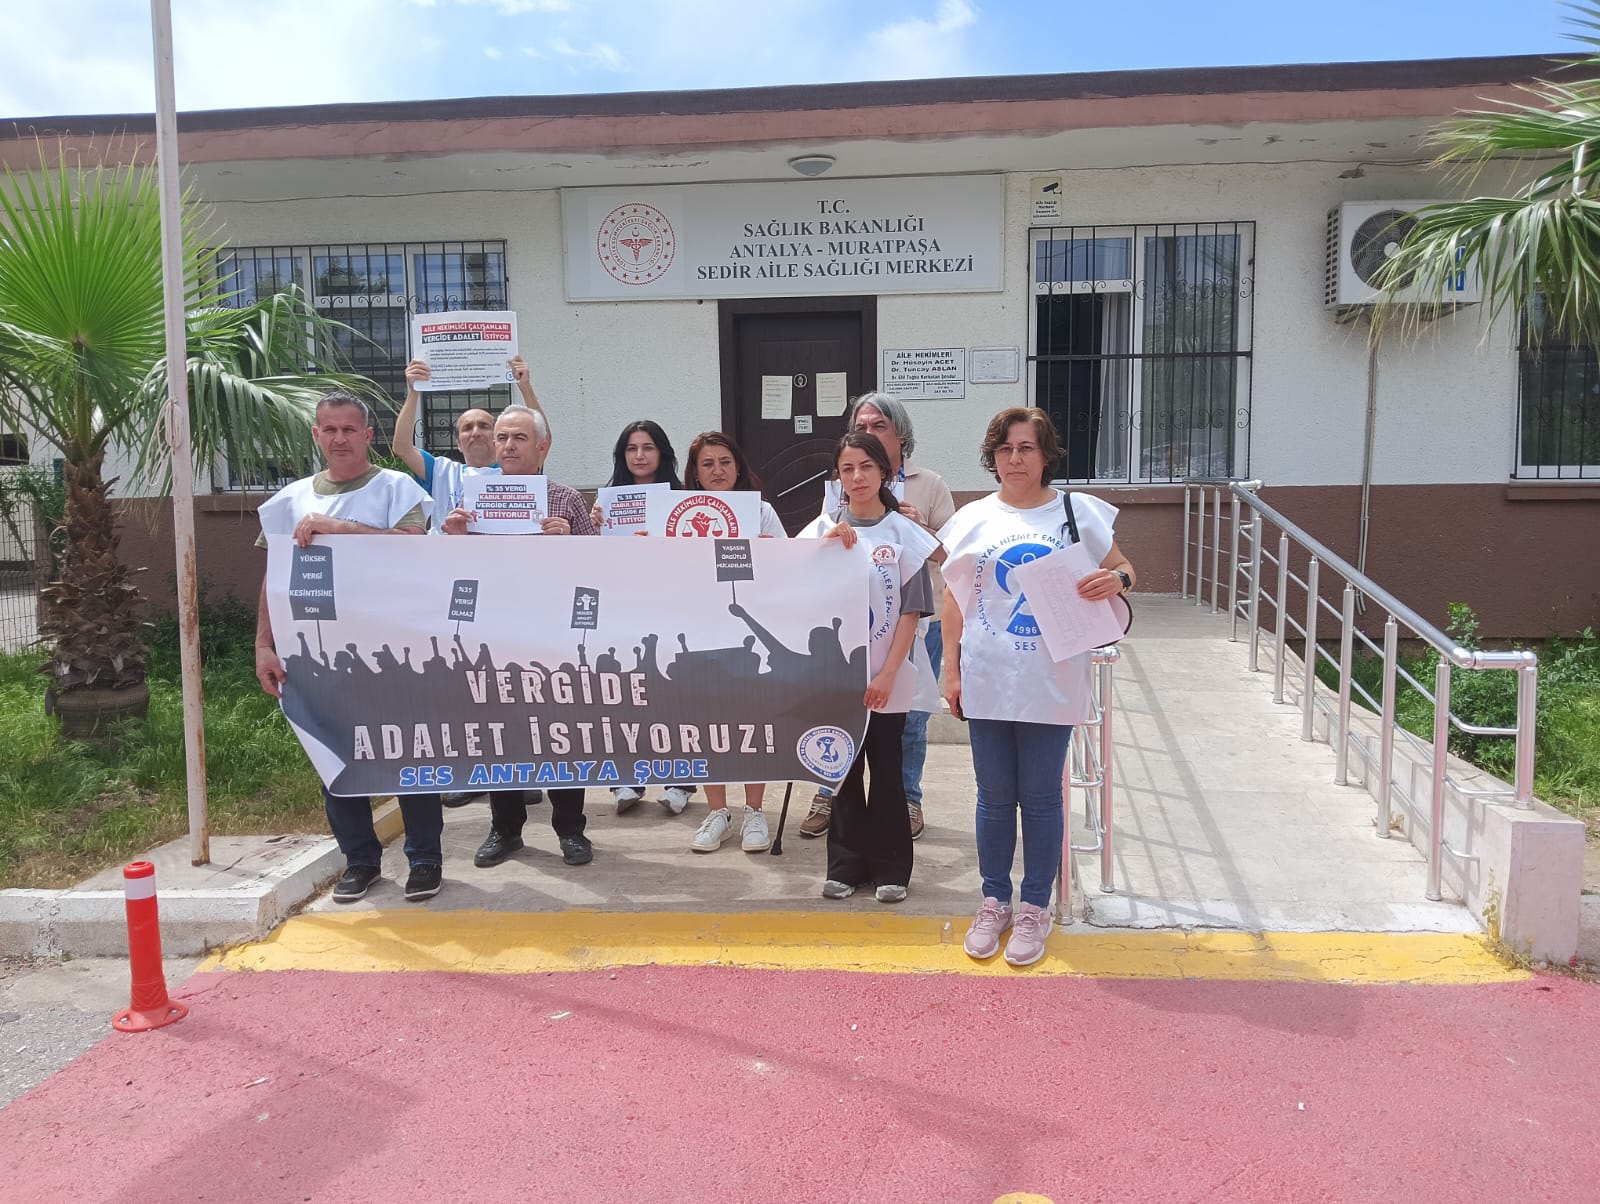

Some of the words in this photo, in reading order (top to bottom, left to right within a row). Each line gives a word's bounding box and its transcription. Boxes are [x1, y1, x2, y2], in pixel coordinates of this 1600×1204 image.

[817, 200, 850, 214] T.C.
[744, 219, 813, 237] SAĞLIK
[819, 214, 925, 235] BAKANLIĞI
[730, 243, 813, 259] ANTALYA
[828, 238, 941, 256] MURATPAŞA
[697, 261, 751, 280] SEDİR
[756, 260, 798, 279] AİLE
[803, 258, 880, 278] SAĞLIĞI
[886, 255, 974, 275] MERKEZİ
[424, 325, 437, 333] AİLE
[437, 322, 467, 331] HEKİMLİĞİ
[468, 323, 509, 331] ÇALIŞANLARI
[424, 333, 451, 343] VERGİDE
[453, 333, 480, 341] ADALET
[484, 332, 510, 341] İSTİYOR
[915, 350, 952, 358] HEKİMLERİ
[505, 484, 526, 492] VERGİ
[476, 501, 507, 509] VERGİDE
[485, 510, 528, 518] İSTİYORUZ
[667, 517, 676, 533] AİLE
[674, 496, 706, 517] HEKİMLİĞİ
[707, 498, 737, 533] ÇALIŞANLARI
[1041, 534, 1065, 550] EMEK
[300, 554, 327, 562] YÜKSEK
[976, 544, 999, 579] SOSYAL
[302, 571, 323, 580] VERGİ
[289, 588, 333, 597] KESİNTİSİNE
[975, 583, 982, 594] VE
[455, 597, 474, 605] VERGİ
[451, 609, 474, 617] OLMAZ
[1014, 625, 1037, 634] 1996
[1014, 641, 1037, 651] SES
[465, 665, 648, 706] VERGİDE
[353, 721, 506, 760] ADALET
[528, 716, 776, 755] İSTİYORUZ!
[400, 765, 454, 787] SES
[468, 760, 619, 785] ANTALYA
[633, 758, 709, 785] ŞUBE
